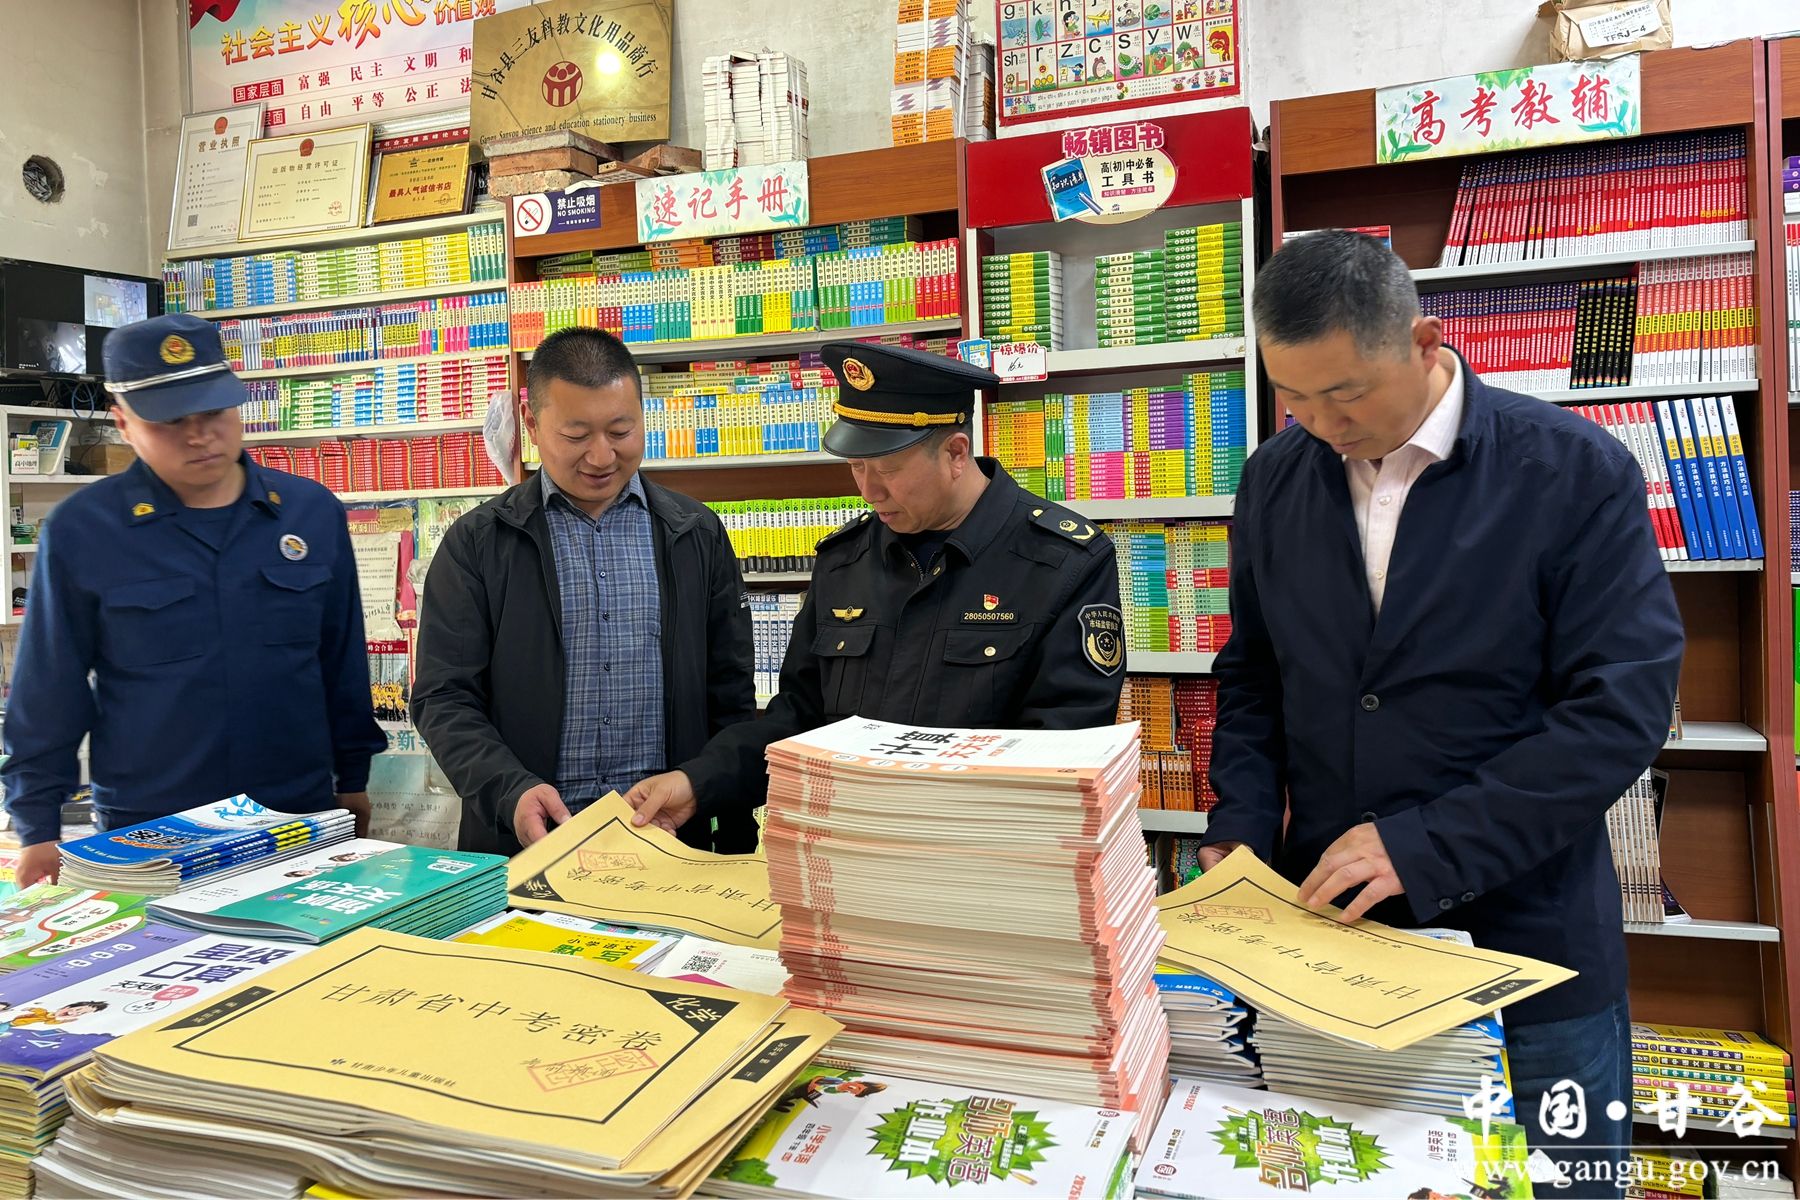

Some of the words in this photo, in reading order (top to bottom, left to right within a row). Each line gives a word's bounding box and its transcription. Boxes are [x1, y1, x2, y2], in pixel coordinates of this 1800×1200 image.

[1003, 4, 1015, 19] g
[1032, 1, 1043, 15] k
[481, 11, 659, 101] 甘谷县三友科教文化用品商行
[1004, 53, 1018, 67] sh
[1036, 47, 1043, 62] r
[234, 81, 283, 102] 国家层面
[298, 72, 331, 91] 富强
[350, 62, 384, 82] 民主
[403, 52, 438, 73] 文明
[300, 101, 332, 121] 自由
[351, 91, 385, 112] 平等
[404, 83, 439, 104] 公正
[1411, 74, 1610, 146] 高考教辅
[521, 125, 543, 136] science
[544, 123, 557, 132] and
[559, 118, 590, 130] education
[593, 114, 626, 127] stationery
[628, 112, 657, 124] business
[198, 135, 241, 153] 营业执照
[1063, 123, 1165, 158] 畅销图书
[271, 159, 339, 175] 出版物经营许可证
[1100, 157, 1155, 174] 高(初)中必备
[1101, 171, 1155, 188] 工具书
[388, 182, 452, 199] 最具人气诚信书店
[557, 194, 596, 210] 禁止吸烟
[653, 174, 789, 228] 速记手册
[567, 206, 596, 216] SMOKING
[1000, 343, 1039, 356] 惊爆价
[1674, 463, 1688, 499] 方法技巧合集
[1690, 462, 1703, 498] 方法技巧合集
[1707, 461, 1720, 497] 方法技巧合集
[1720, 461, 1732, 497] 方法技巧合集
[1736, 459, 1749, 496] 方法技巧合集
[963, 612, 1015, 622] 28050507560
[293, 879, 403, 904] 天天练
[566, 867, 778, 913] 甘肃省中考密卷
[184, 943, 297, 965] 星级
[568, 938, 637, 951] 小学语文
[1176, 912, 1422, 1000] 甘肃省中考密卷
[110, 979, 171, 992] 天天练
[138, 961, 255, 983] 口算
[320, 982, 663, 1053] 甘肃省中考密卷
[666, 996, 722, 1024] 化学
[351, 1060, 457, 1088] 甘肃少年儿童出版社
[793, 1124, 832, 1165] 小学英语
[898, 1099, 955, 1165] 作业本
[949, 1095, 1017, 1184] 名师英语
[1427, 1128, 1444, 1162] 小学英语
[1256, 1107, 1312, 1194] 名师英语
[1311, 1124, 1360, 1184] 作业本
